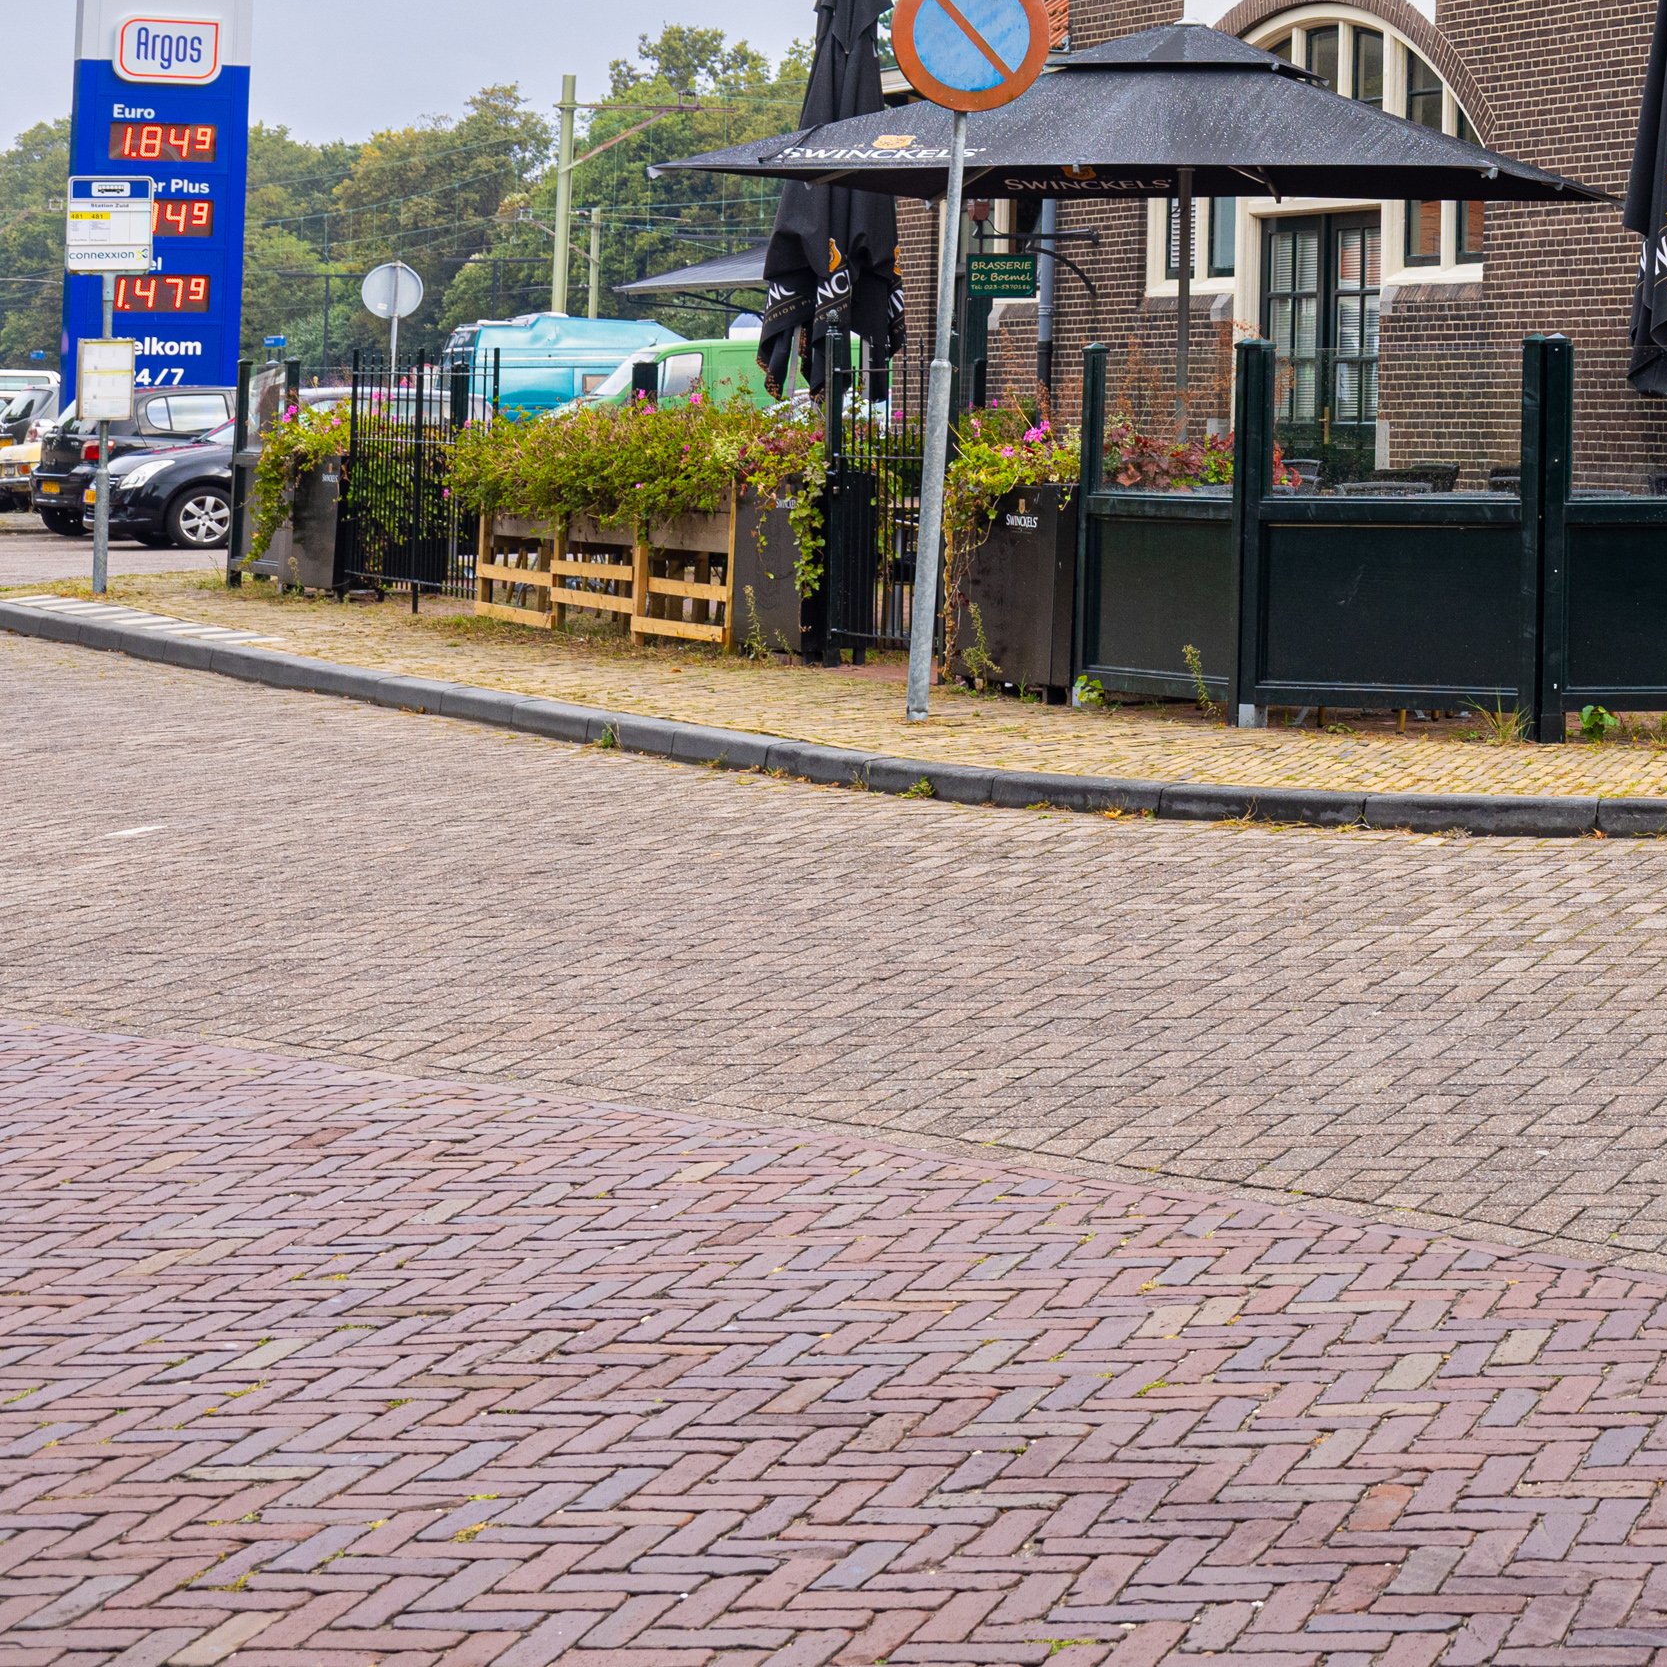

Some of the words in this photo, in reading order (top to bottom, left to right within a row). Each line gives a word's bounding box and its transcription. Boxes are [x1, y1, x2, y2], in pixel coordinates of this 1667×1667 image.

[136, 26, 203, 70] Argos
[113, 103, 155, 119] Euro
[123, 125, 213, 158] 1.849
[170, 178, 210, 194] Plus
[69, 250, 134, 261] connexxion
[971, 261, 1032, 270] BRASSERIE
[971, 273, 987, 282] De
[990, 272, 1033, 282] Boemel
[117, 278, 206, 309] 1.479
[134, 337, 202, 356] elkom
[134, 368, 185, 386] 4/7
